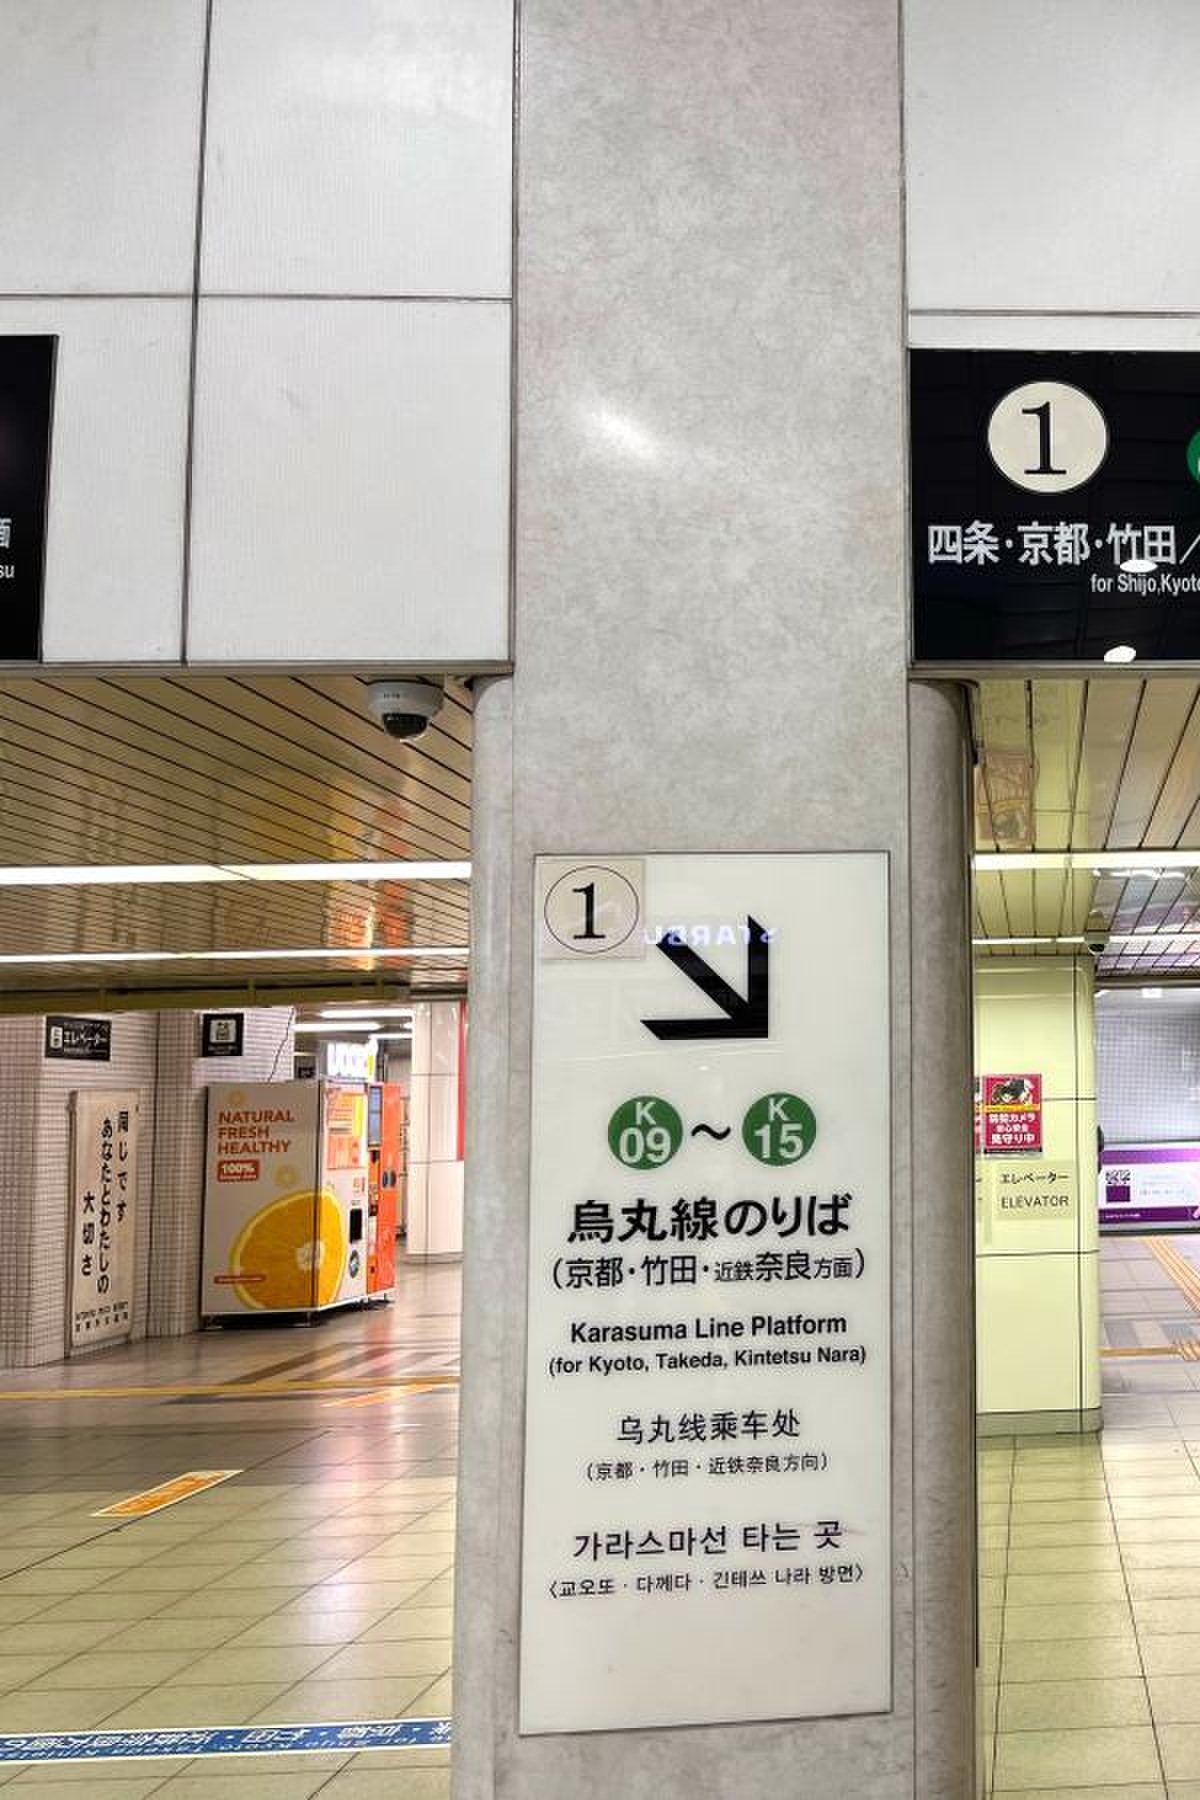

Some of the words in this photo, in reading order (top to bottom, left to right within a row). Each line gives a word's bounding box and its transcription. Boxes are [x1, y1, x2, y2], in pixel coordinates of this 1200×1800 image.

[1090, 573, 1113, 593] for
[218, 1109, 295, 1124] NATURAL
[218, 1125, 271, 1140] FRESH
[218, 1139, 292, 1154] HEALTHY
[618, 1126, 673, 1164] 09
[754, 1123, 803, 1160] 15
[1000, 1172, 1070, 1185] エレベーター
[1001, 1195, 1070, 1209] ELEVATOR
[568, 1193, 853, 1244] 烏丸線のりば
[571, 1321, 688, 1344] Karasuma
[695, 1317, 745, 1340] Line
[751, 1313, 848, 1337] Platform
[549, 1357, 583, 1378] (for
[589, 1355, 650, 1376] Kyoto,
[655, 1350, 729, 1371] Takeda,
[735, 1348, 812, 1368] Kintetsu
[817, 1345, 867, 1366] Nara)
[617, 1408, 801, 1445] 乌丸线乘车处
[573, 1526, 727, 1561] 가라스마선
[743, 1523, 801, 1553] 타는
[813, 1520, 843, 1550] 곳
[775, 1567, 809, 1584] 나라
